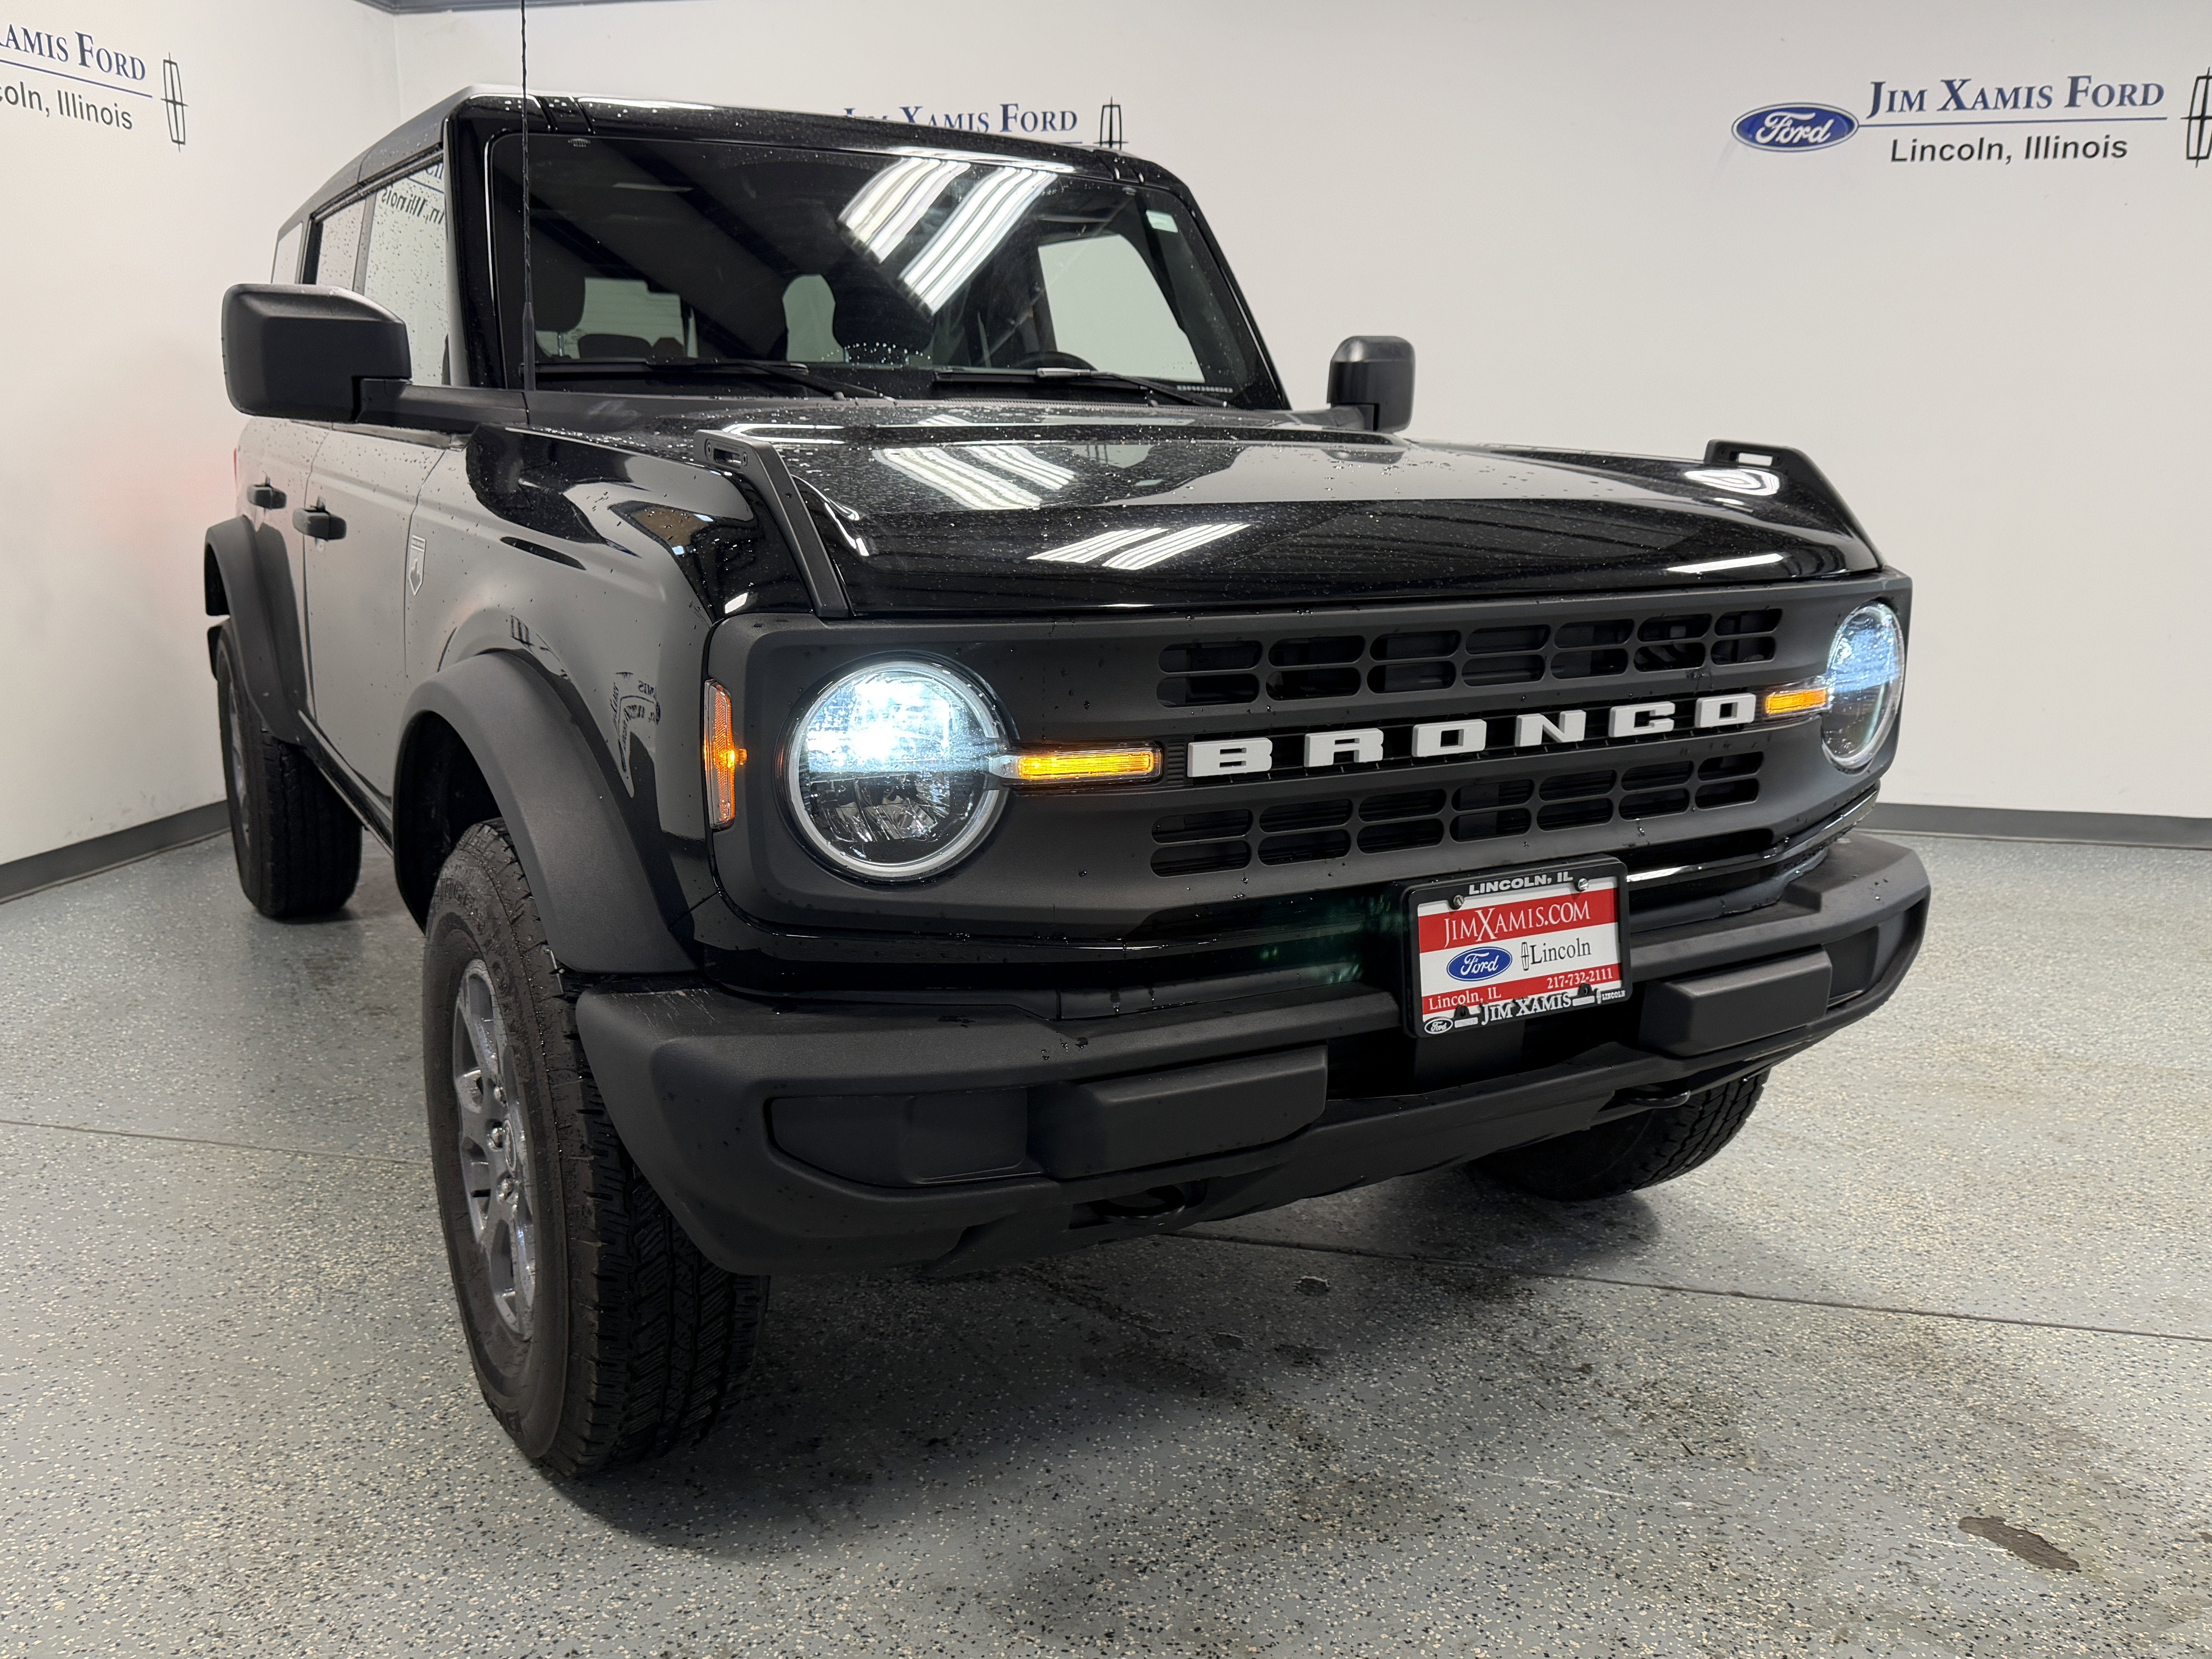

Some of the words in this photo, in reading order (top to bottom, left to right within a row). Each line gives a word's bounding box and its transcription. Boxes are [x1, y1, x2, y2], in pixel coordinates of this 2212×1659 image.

[0, 24, 69, 62] AMIS
[75, 31, 146, 81] FORD
[0, 81, 50, 117] oln,
[57, 89, 133, 130] Illinois
[1866, 81, 1928, 119] JIM
[1936, 79, 2052, 111] XAMIS
[2064, 75, 2164, 108] FORD
[999, 103, 1078, 132] FORD
[1755, 112, 1834, 144] Ford
[1891, 137, 2012, 165] Lincoln,
[2024, 134, 2128, 160] Illinois
[1187, 693, 1757, 778] BRONCO
[1468, 874, 1552, 895] LINCOLN,
[1557, 871, 1573, 882] IL
[1460, 952, 1499, 976] Ford
[1530, 938, 1592, 965] Lincoln
[1547, 967, 1613, 989] 217-732-2111
[1429, 990, 1483, 1010] Lincoln,
[1488, 986, 1501, 999] IL
[1481, 1002, 1513, 1025] JIM
[1516, 993, 1571, 1017] XAMIS
[1430, 1021, 1447, 1032] Ford
